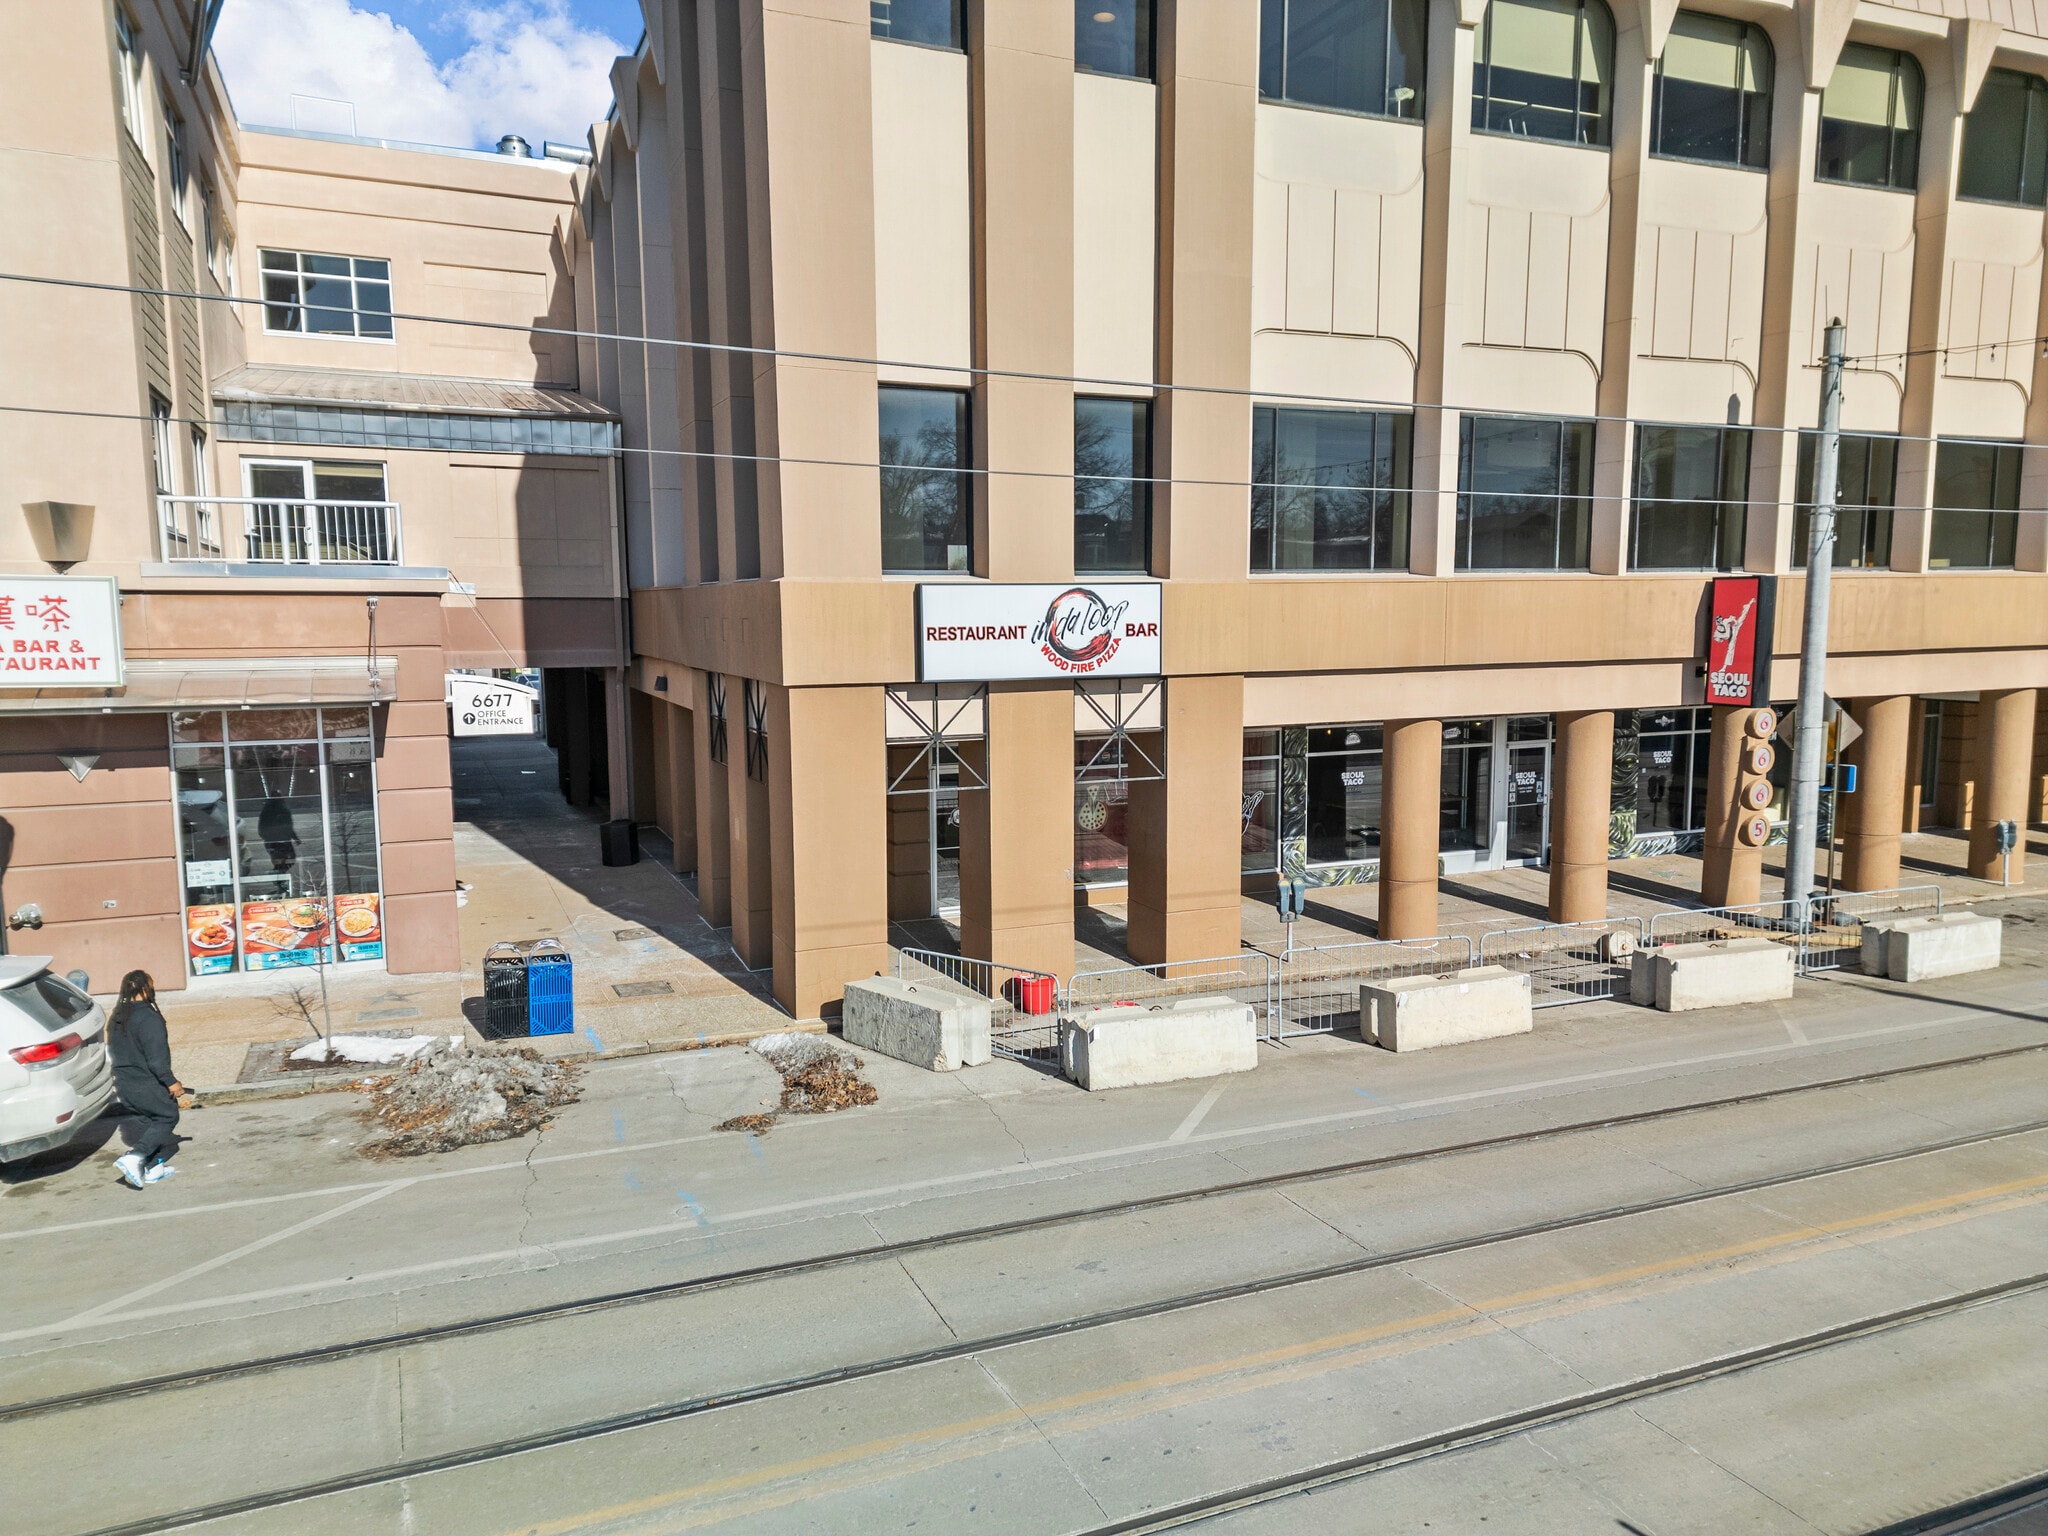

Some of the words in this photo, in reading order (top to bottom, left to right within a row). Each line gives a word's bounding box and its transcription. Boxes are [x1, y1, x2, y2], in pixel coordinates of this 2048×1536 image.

[926, 625, 1028, 642] RESTAURANT
[1125, 622, 1159, 637] BAR
[13, 639, 60, 653] BAR
[69, 639, 85, 653] &
[1041, 643, 1069, 671] WOOD
[1070, 661, 1095, 673] FIRE
[1096, 638, 1122, 667] PIZZA
[1710, 671, 1751, 686] SEOUL
[1713, 684, 1748, 698] TACO
[472, 694, 512, 707] 6677
[477, 717, 523, 725] ENTRANCE
[1341, 771, 1365, 780] SEOUL
[1343, 778, 1364, 786] TACO
